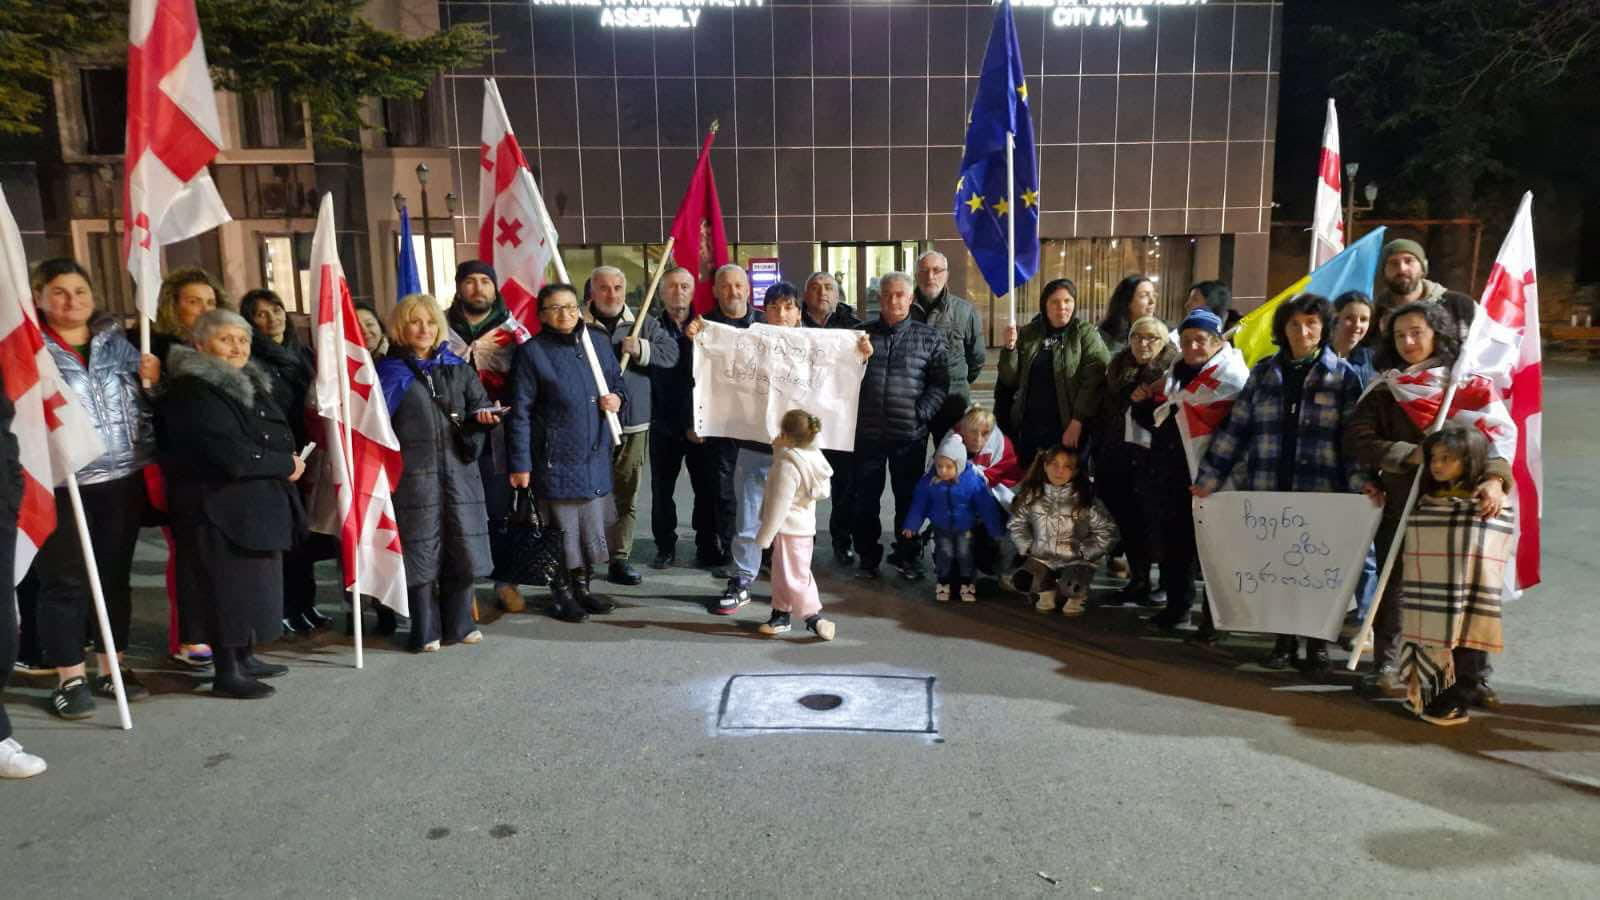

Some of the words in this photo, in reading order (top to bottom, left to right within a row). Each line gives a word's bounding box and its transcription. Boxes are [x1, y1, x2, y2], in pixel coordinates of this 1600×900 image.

[600, 7, 701, 27] ASSEMBLY
[1053, 7, 1097, 26] CITY
[1099, 7, 1148, 26] HALL
[1244, 499, 1309, 540] ჩვენი
[1283, 531, 1330, 566] გზა
